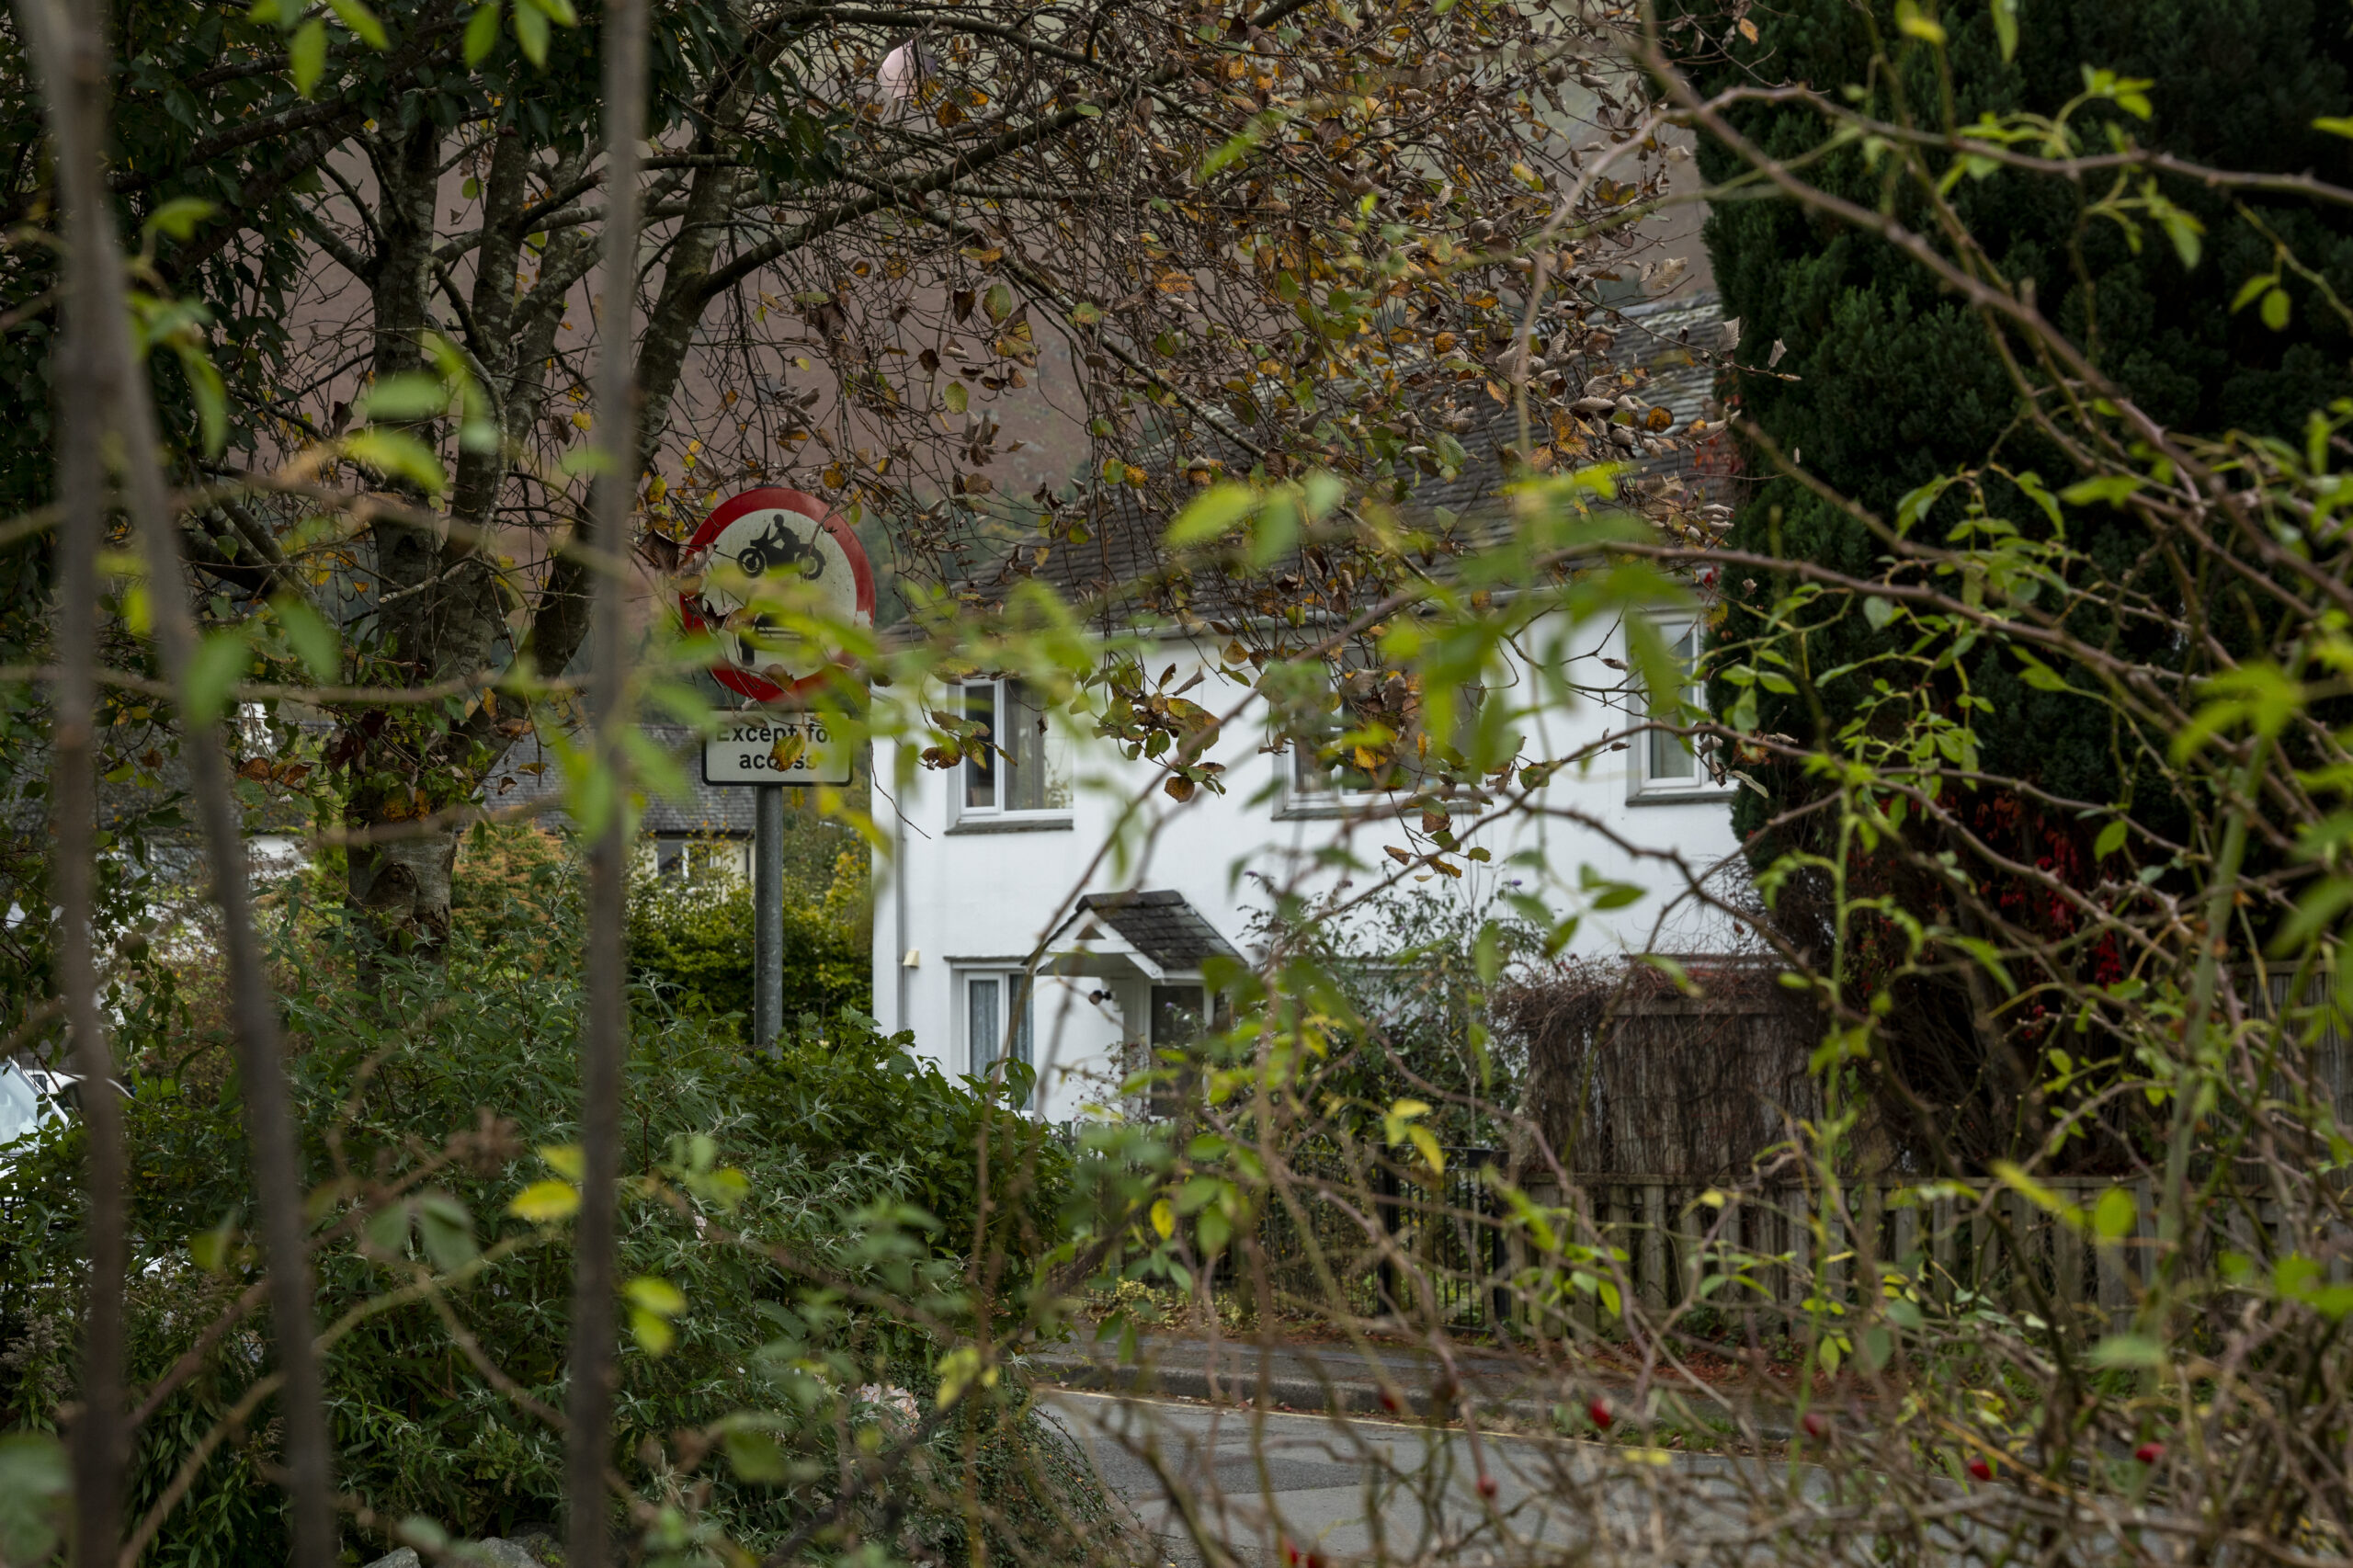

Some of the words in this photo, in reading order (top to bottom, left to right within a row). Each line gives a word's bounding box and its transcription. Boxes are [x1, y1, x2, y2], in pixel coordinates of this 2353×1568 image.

[716, 722, 799, 744] Except
[807, 722, 837, 743] fo
[739, 754, 817, 770] accss
